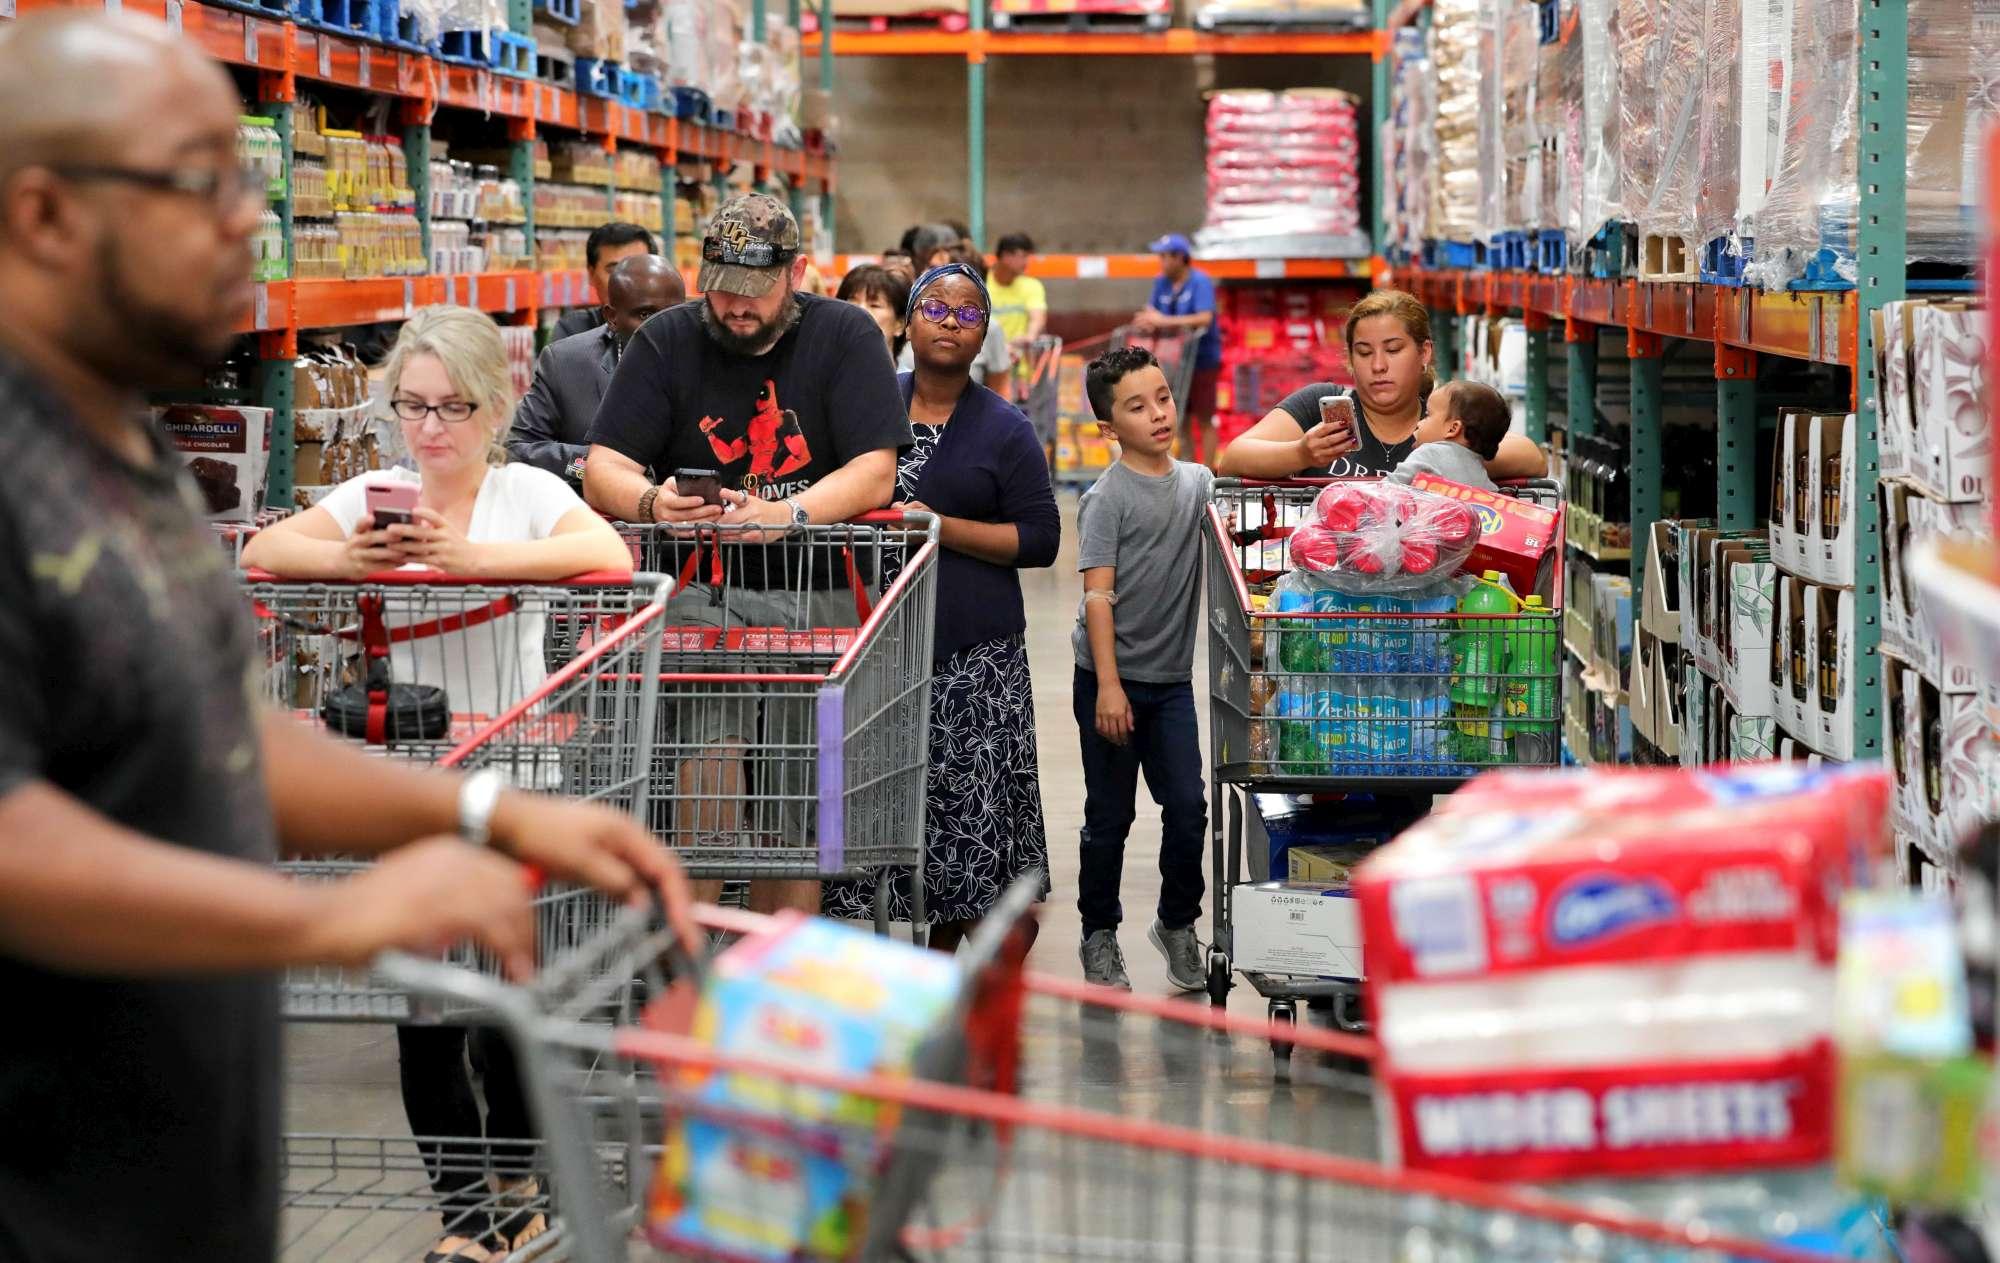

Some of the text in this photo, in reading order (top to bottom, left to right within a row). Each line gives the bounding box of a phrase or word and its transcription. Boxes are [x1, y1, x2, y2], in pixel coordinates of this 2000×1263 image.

[164, 423, 238, 434] GHIRARDELLI
[193, 441, 230, 449] CHOCOLATE
[1316, 595, 1409, 626] Zephhills
